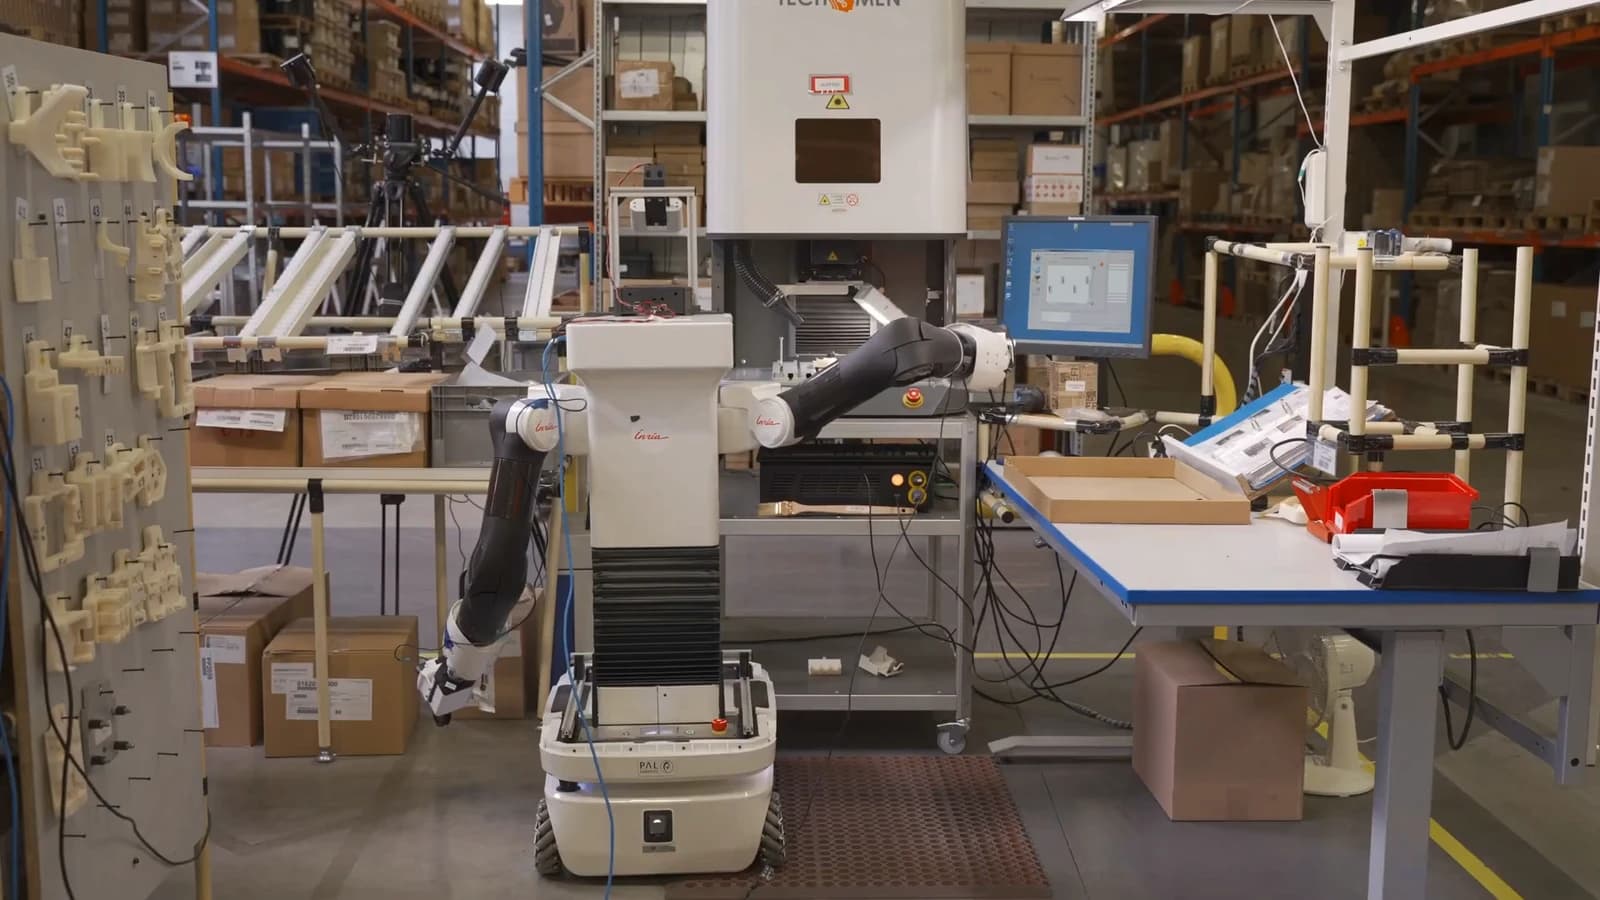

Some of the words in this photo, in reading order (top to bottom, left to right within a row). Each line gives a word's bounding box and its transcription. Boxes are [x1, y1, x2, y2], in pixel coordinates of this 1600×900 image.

[92, 205, 101, 217] 43
[64, 326, 73, 338] 47
[33, 457, 43, 471] 51
